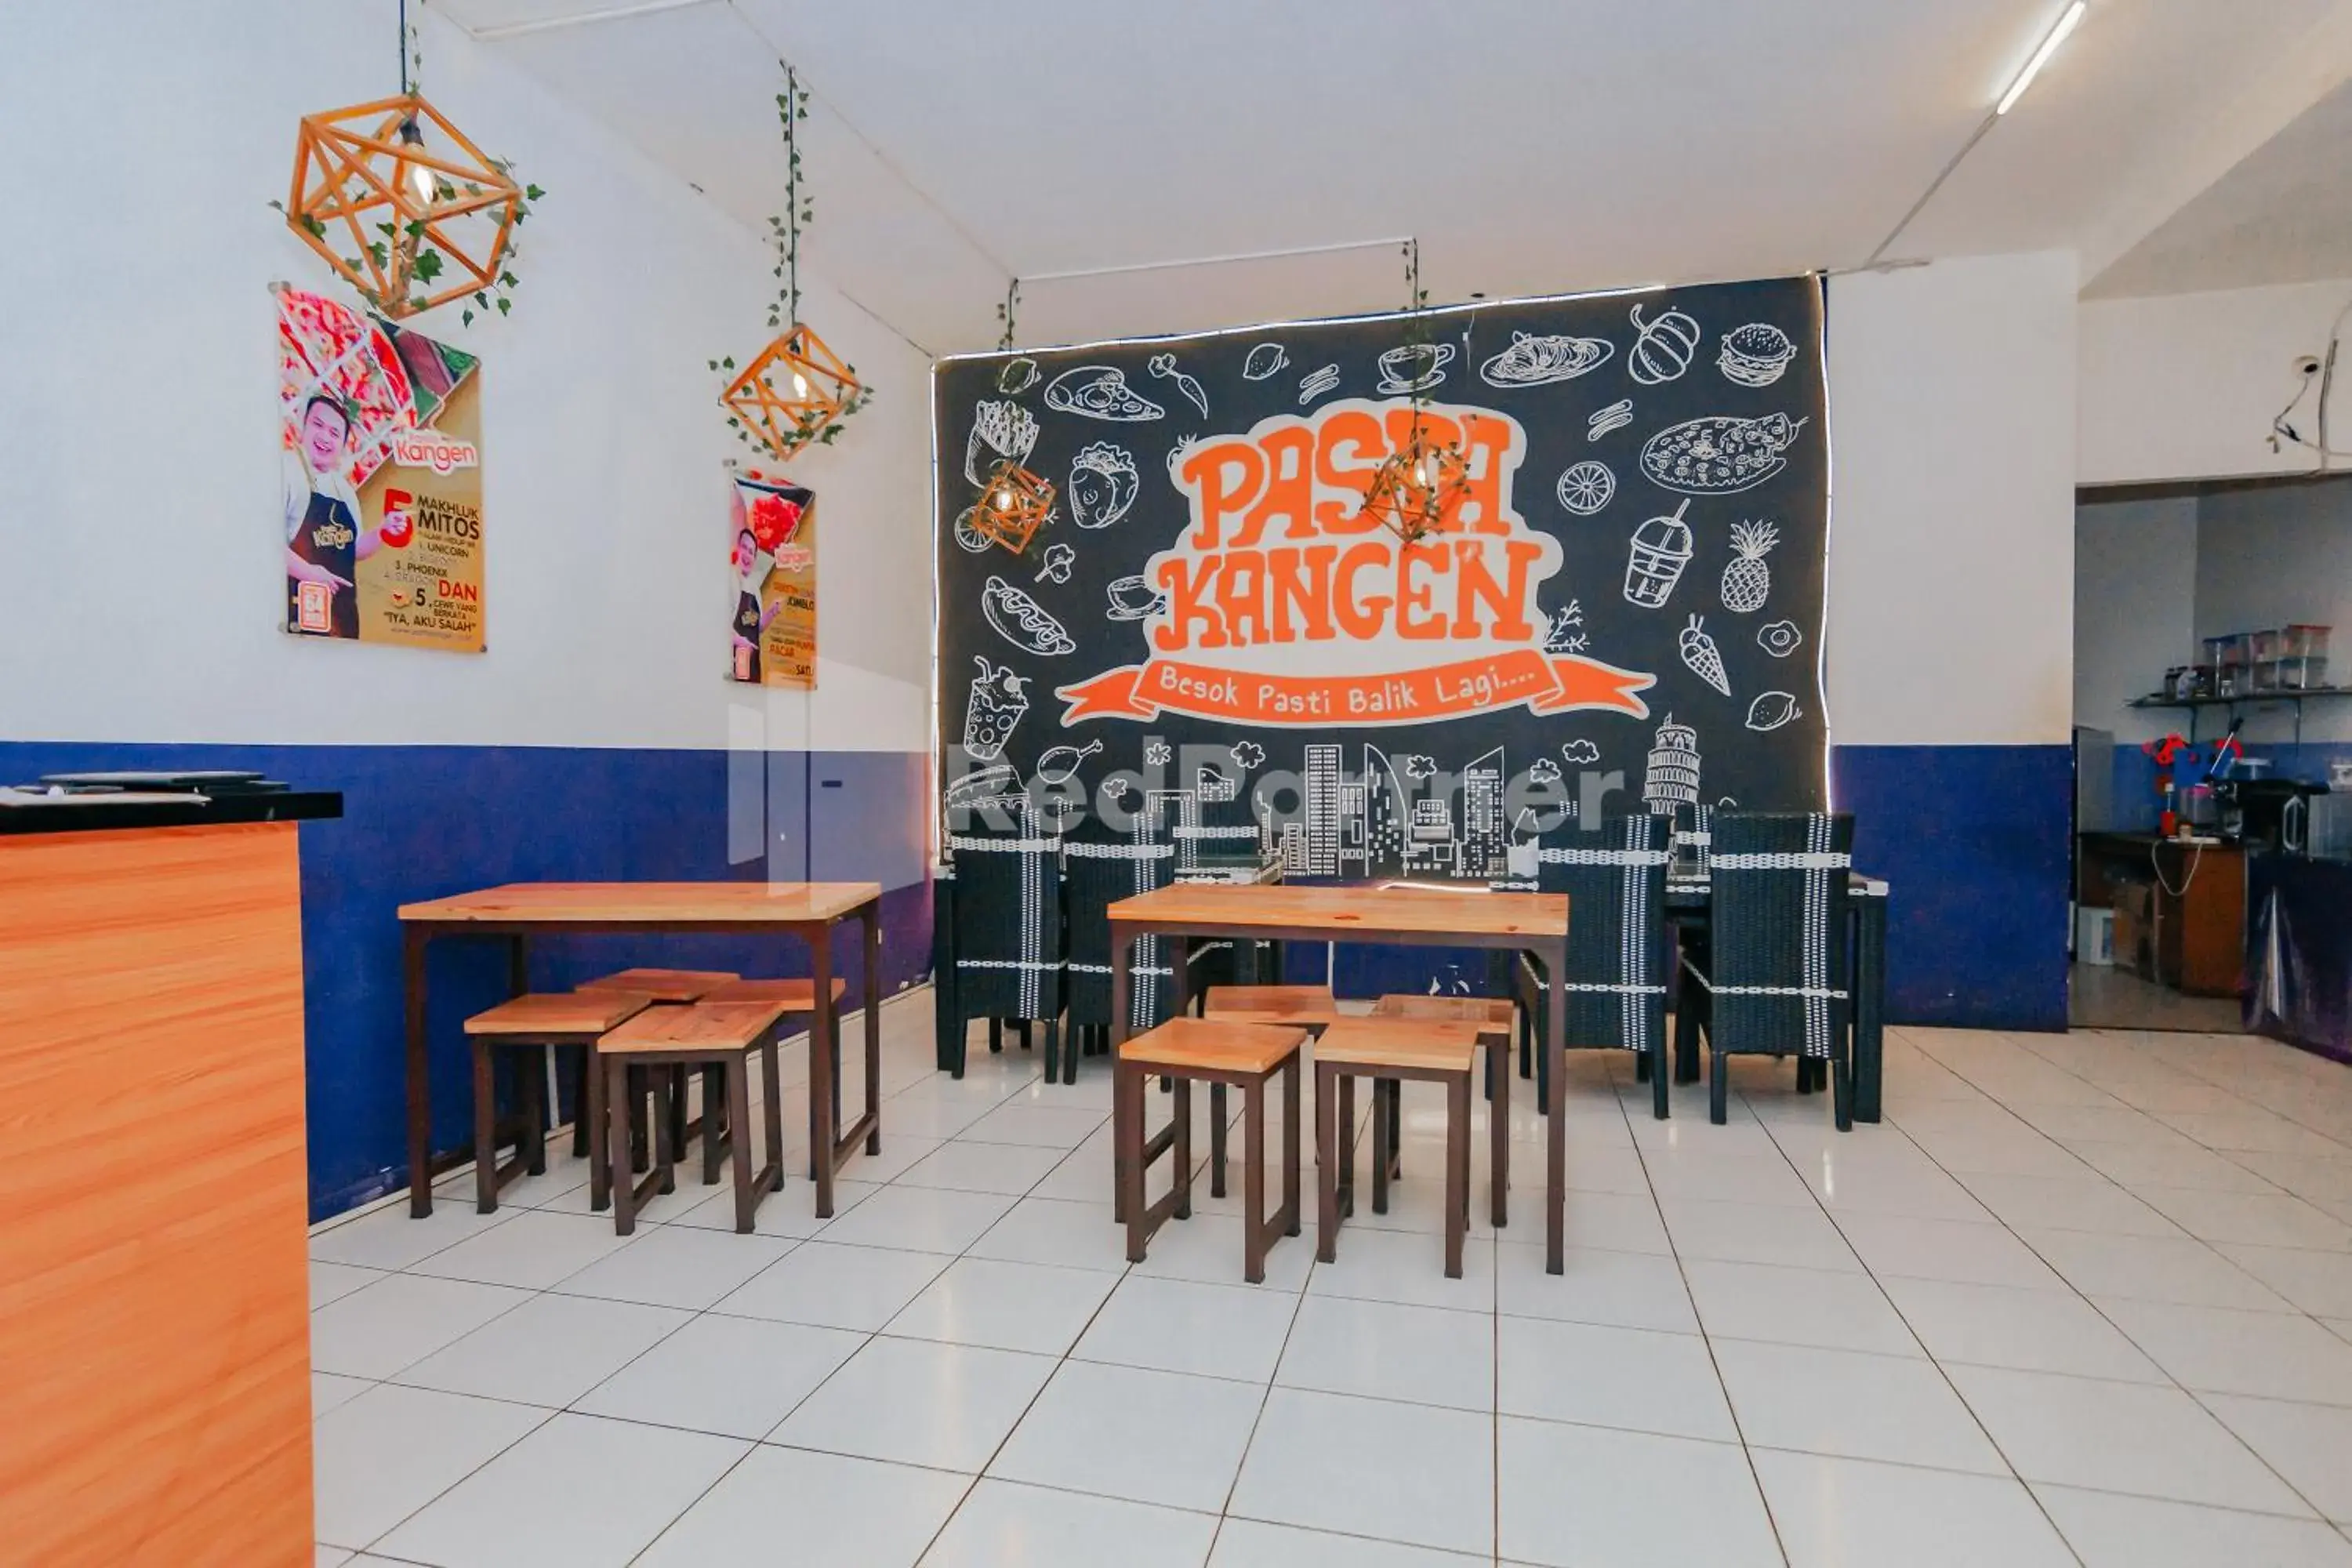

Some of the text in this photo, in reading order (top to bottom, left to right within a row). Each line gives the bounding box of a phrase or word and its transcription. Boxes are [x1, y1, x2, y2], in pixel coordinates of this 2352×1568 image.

[397, 438, 474, 471] Kangen
[1182, 408, 1512, 550] PASTA
[379, 488, 414, 549] 5
[416, 494, 480, 522] MAKHLUK
[417, 509, 480, 541] MITOS
[438, 579, 477, 602] DAN
[1152, 539, 1542, 652] KANGEN
[413, 615, 437, 629] AKU
[1160, 665, 1240, 706] Besok
[1258, 684, 1330, 714] Pasti
[1348, 680, 1419, 713] Balik
